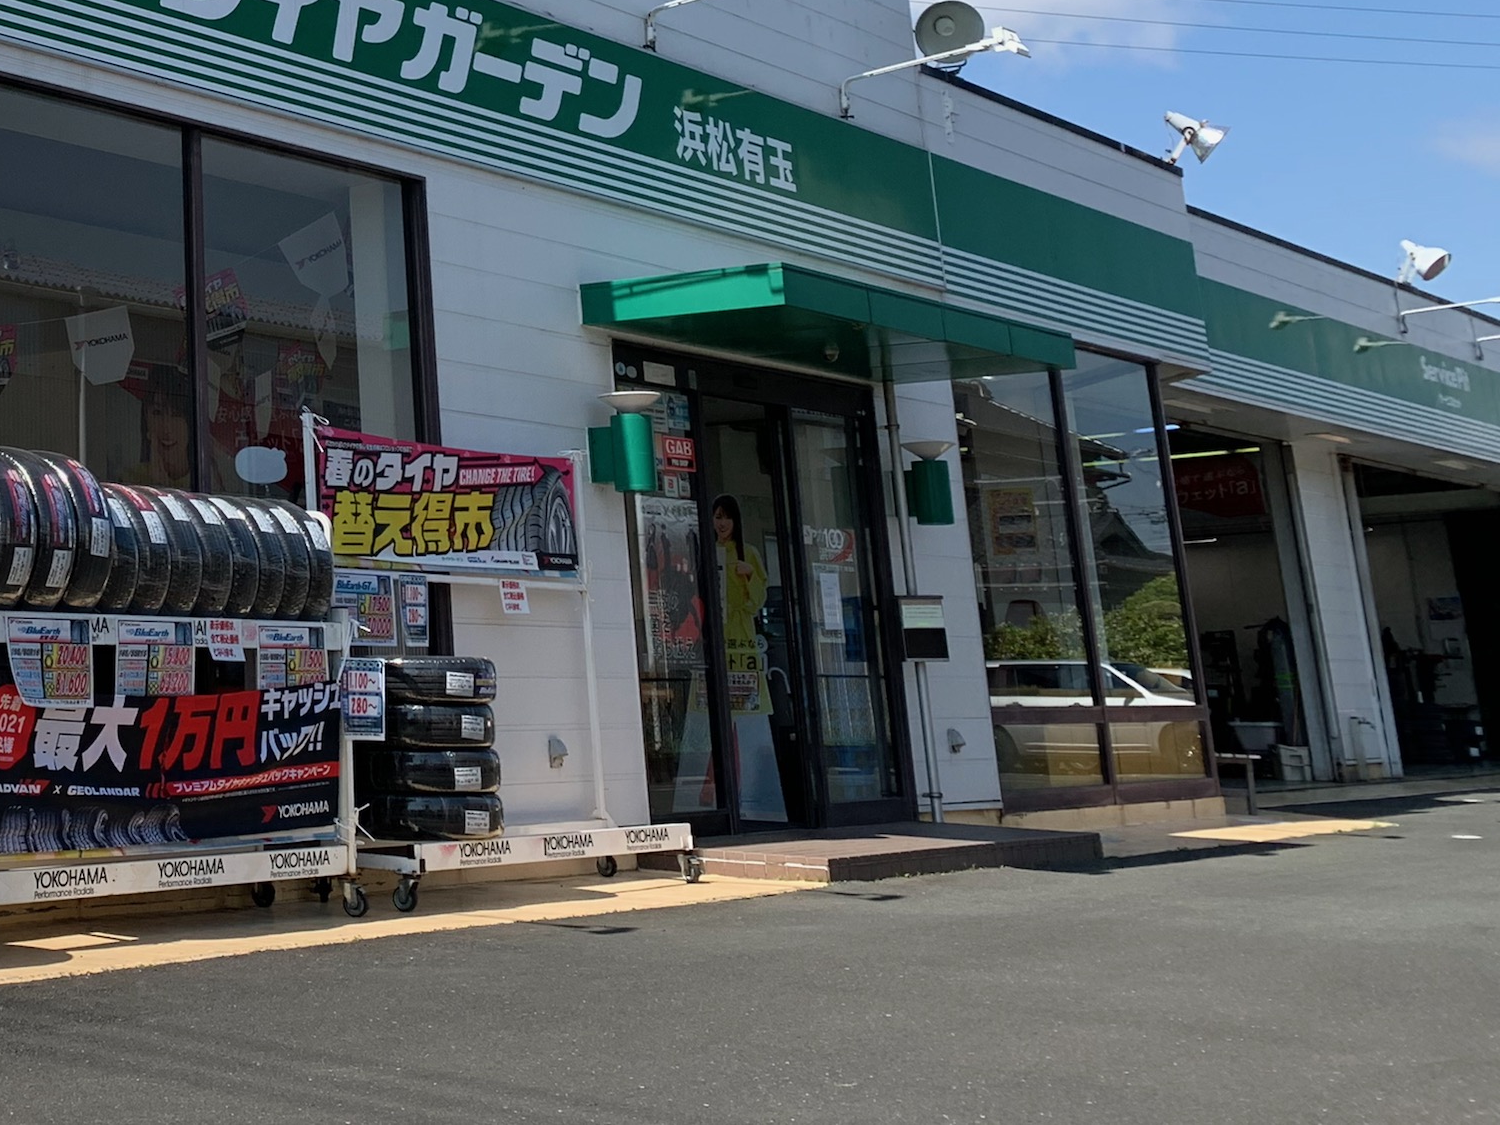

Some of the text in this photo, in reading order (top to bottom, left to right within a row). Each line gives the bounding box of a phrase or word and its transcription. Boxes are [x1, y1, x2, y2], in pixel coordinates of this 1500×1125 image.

[673, 105, 797, 193] 浜松有玉
[665, 439, 693, 456] GAB
[325, 448, 459, 493] 春のタイヤ
[459, 469, 496, 486] CHANGE
[497, 468, 513, 484] THE
[333, 490, 496, 556] 替え得市
[66, 784, 141, 797] GEOLANDAR
[278, 799, 330, 819] YOKOHAMA
[547, 834, 594, 851] YOKOHAMA
[625, 828, 669, 844] YOKOHAMA
[458, 840, 512, 858] YOKOHAMA
[158, 858, 225, 879] YOKOHAMA
[270, 849, 331, 870] YOKOHAMA
[33, 866, 108, 889] YOKOHAMA
[159, 876, 213, 888] Performance Radials
[33, 886, 95, 900] Performance Radials
